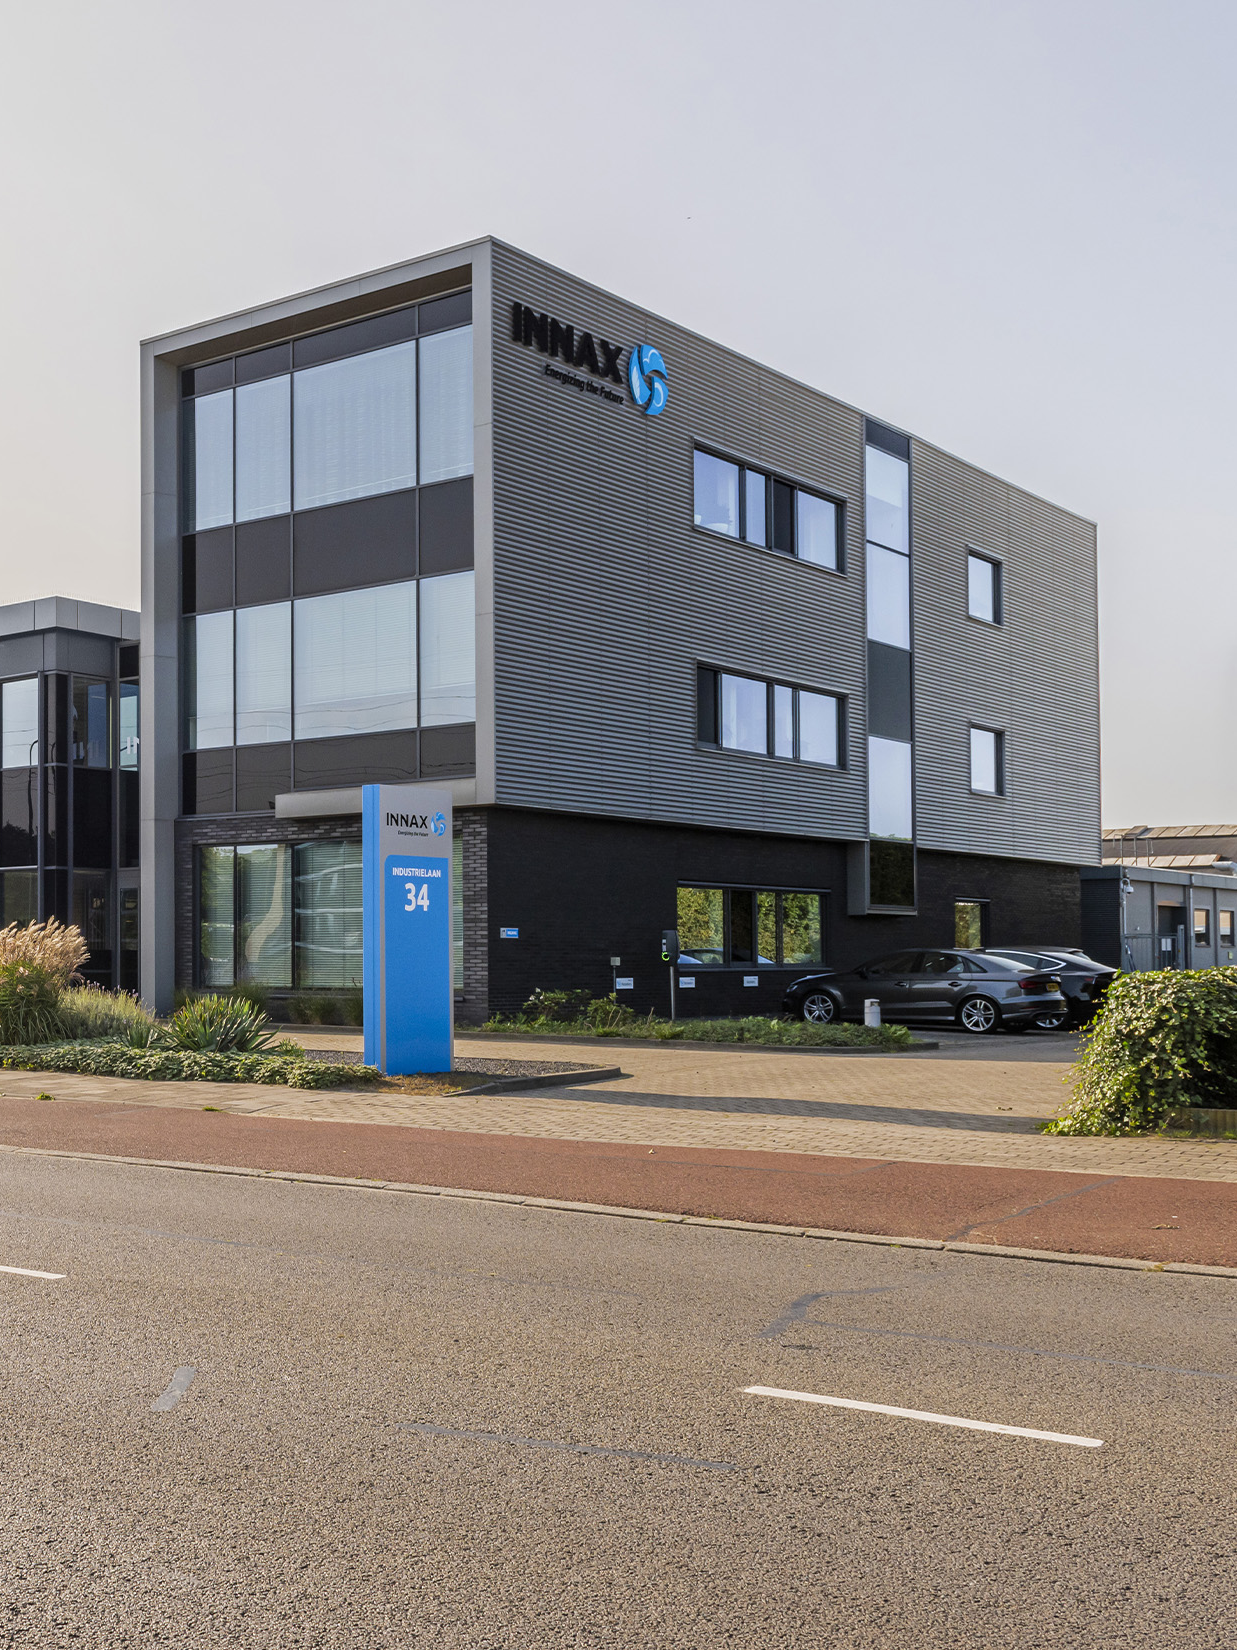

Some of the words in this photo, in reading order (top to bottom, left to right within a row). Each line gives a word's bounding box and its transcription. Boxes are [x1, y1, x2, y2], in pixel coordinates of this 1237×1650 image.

[512, 302, 624, 384] INNAX
[545, 364, 585, 392] Energizing
[586, 380, 599, 395] the
[600, 385, 625, 405] Future
[386, 812, 428, 829] INNAX
[392, 867, 441, 878] INDUSTRIELAAN
[404, 882, 430, 912] 34
